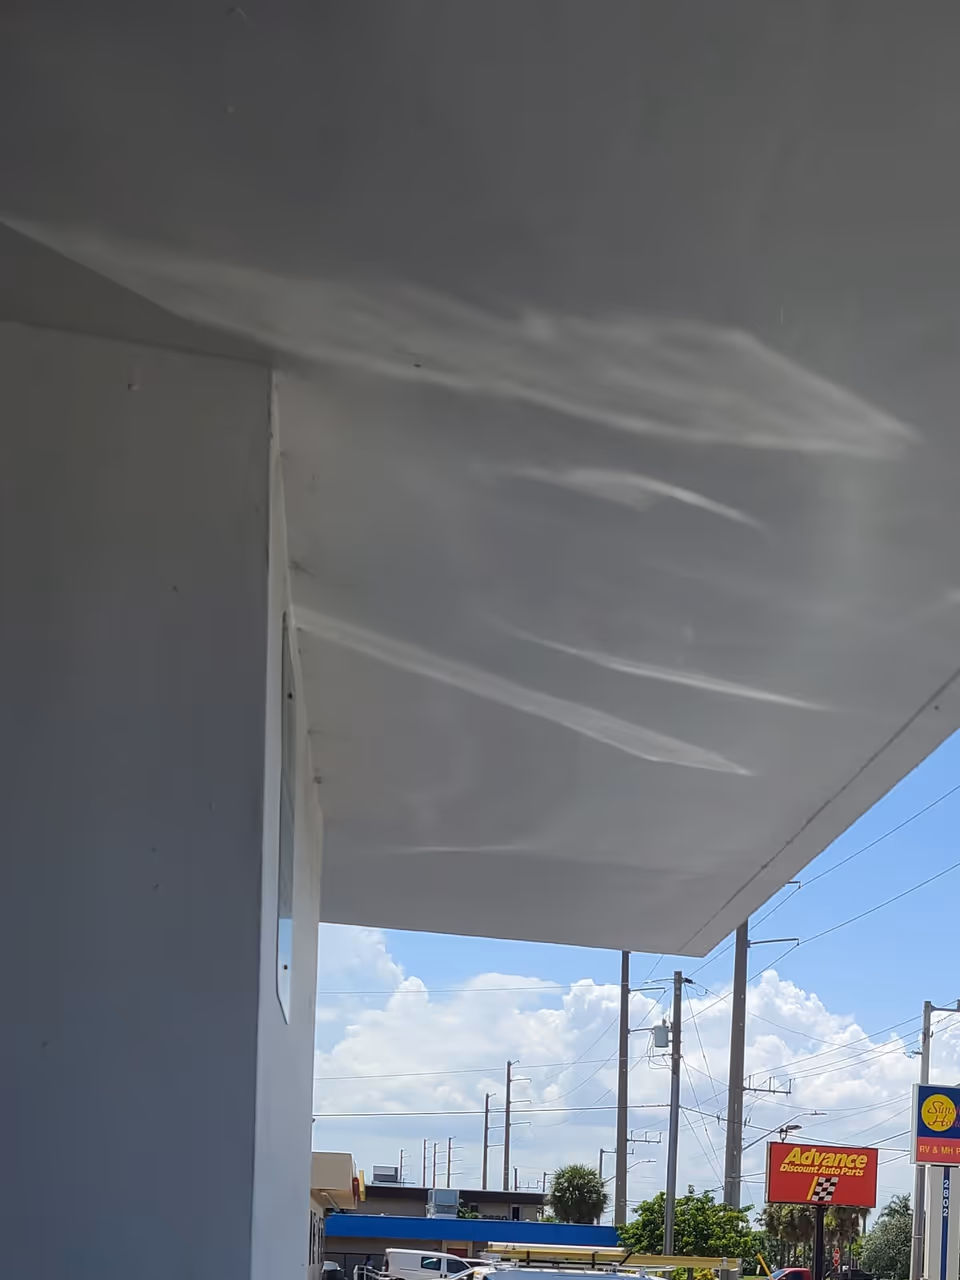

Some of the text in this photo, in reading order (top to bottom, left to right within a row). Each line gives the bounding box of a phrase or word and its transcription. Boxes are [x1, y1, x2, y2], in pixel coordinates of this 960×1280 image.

[783, 1147, 868, 1168] Advance
[919, 1145, 930, 1154] RV
[932, 1146, 938, 1154] &
[941, 1146, 954, 1154] MH
[780, 1163, 864, 1176] Discount Auto Parts
[942, 1179, 950, 1217] 2802
